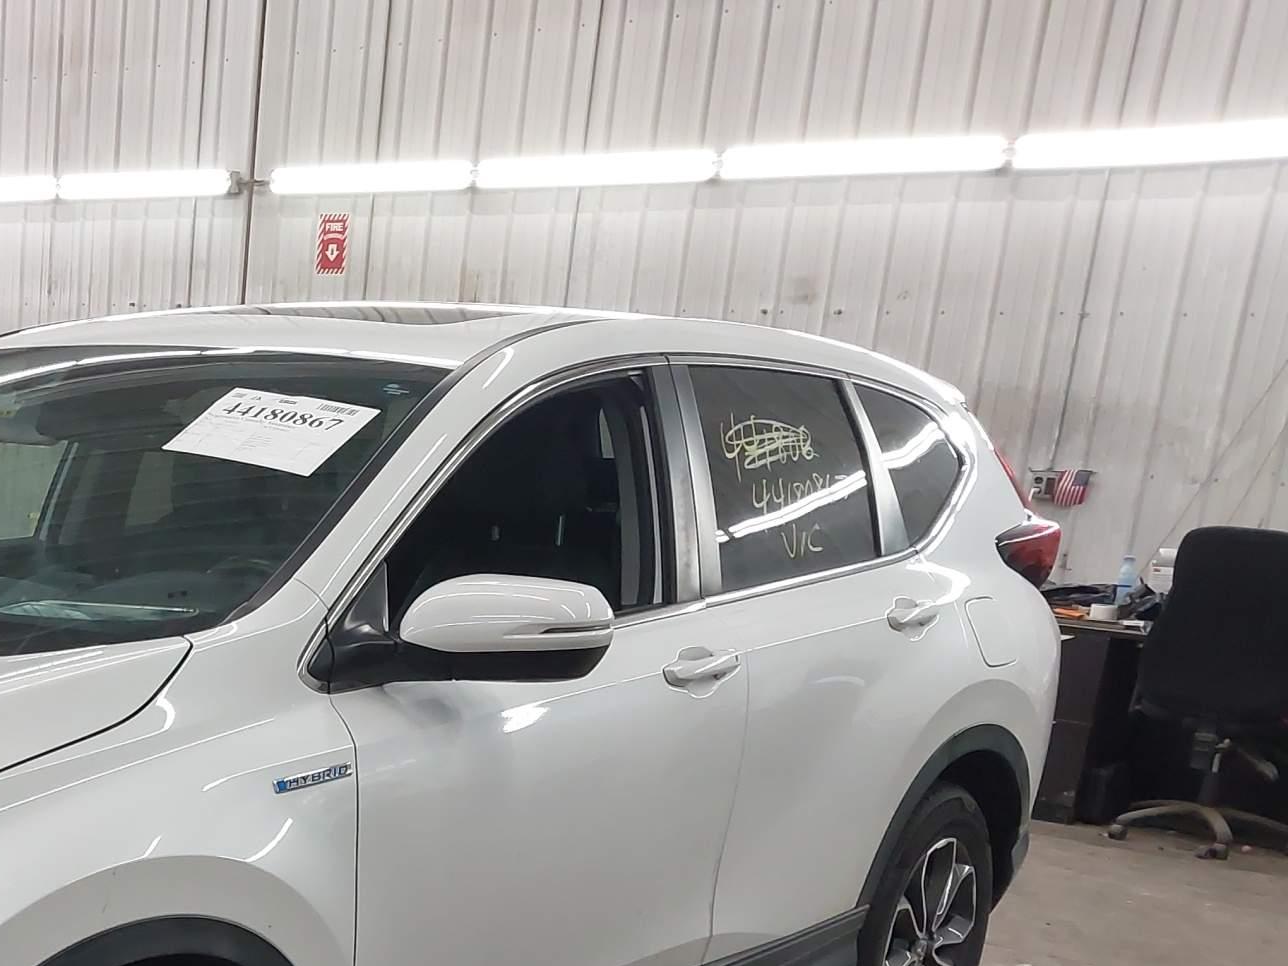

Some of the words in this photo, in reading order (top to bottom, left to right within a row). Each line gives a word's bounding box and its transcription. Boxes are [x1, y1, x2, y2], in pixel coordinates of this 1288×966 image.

[325, 222, 344, 232] FIRE
[222, 402, 344, 431] 44180867
[287, 764, 349, 788] HYBRID
